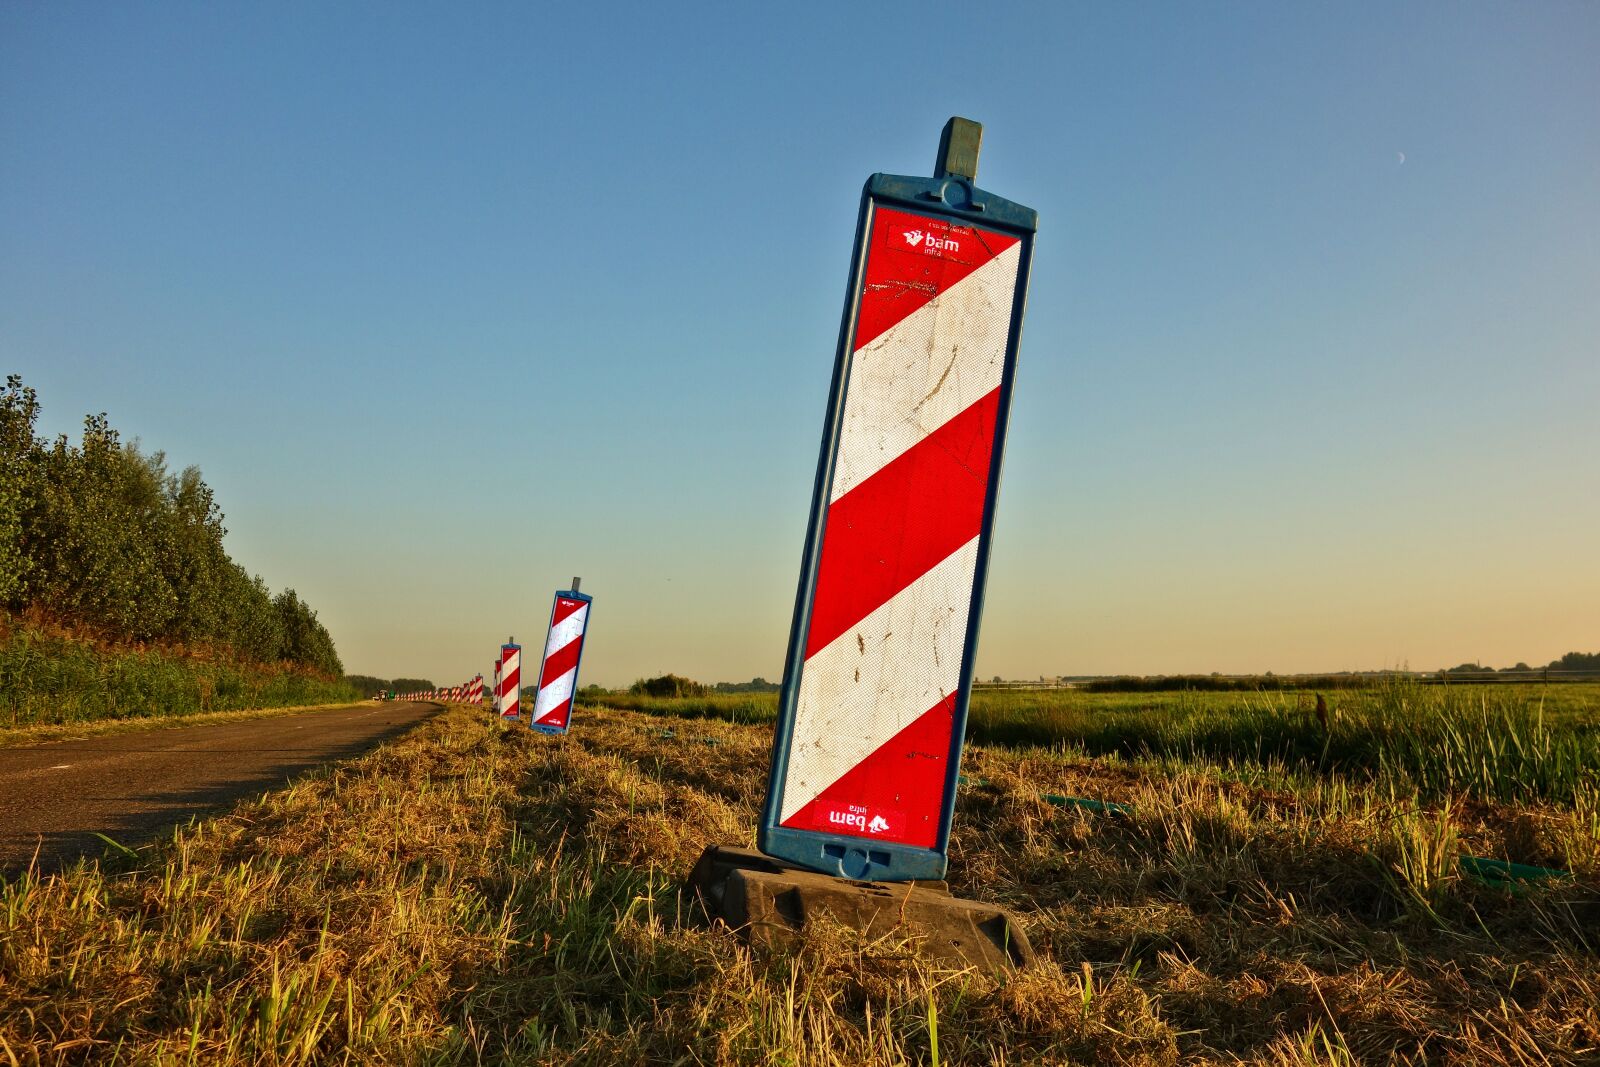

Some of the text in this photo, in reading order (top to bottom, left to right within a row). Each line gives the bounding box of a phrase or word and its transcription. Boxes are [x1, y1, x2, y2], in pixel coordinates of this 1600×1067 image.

[925, 232, 959, 252] bam
[924, 247, 942, 257] infra
[849, 805, 867, 815] infra
[829, 811, 866, 832] bam
